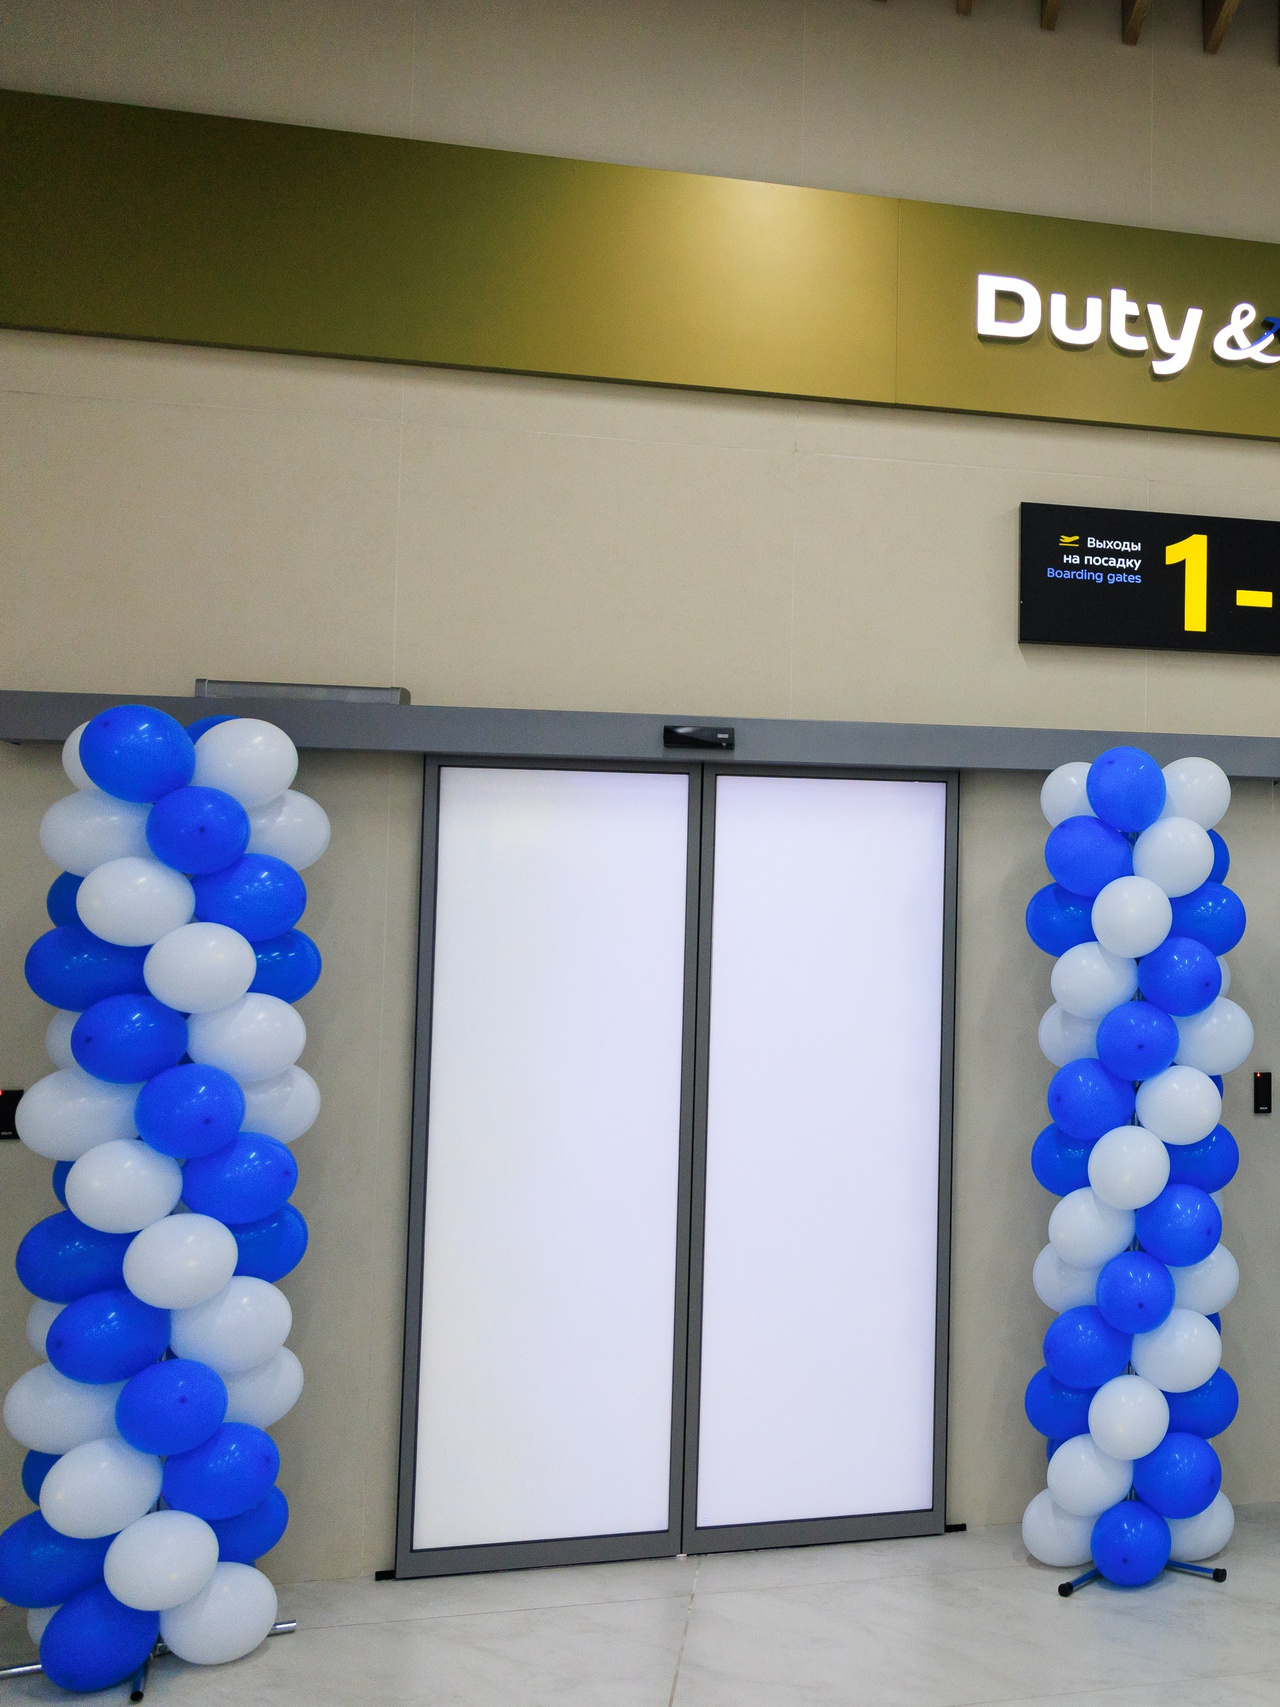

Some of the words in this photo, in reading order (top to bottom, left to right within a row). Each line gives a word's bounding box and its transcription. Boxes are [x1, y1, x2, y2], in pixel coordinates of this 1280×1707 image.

[975, 273, 1203, 377] Duty
[1086, 536, 1142, 553] Выходы
[1063, 553, 1080, 567] на
[1084, 556, 1142, 571] посадку
[1047, 567, 1104, 583] Boarding
[1107, 571, 1142, 585] gates
